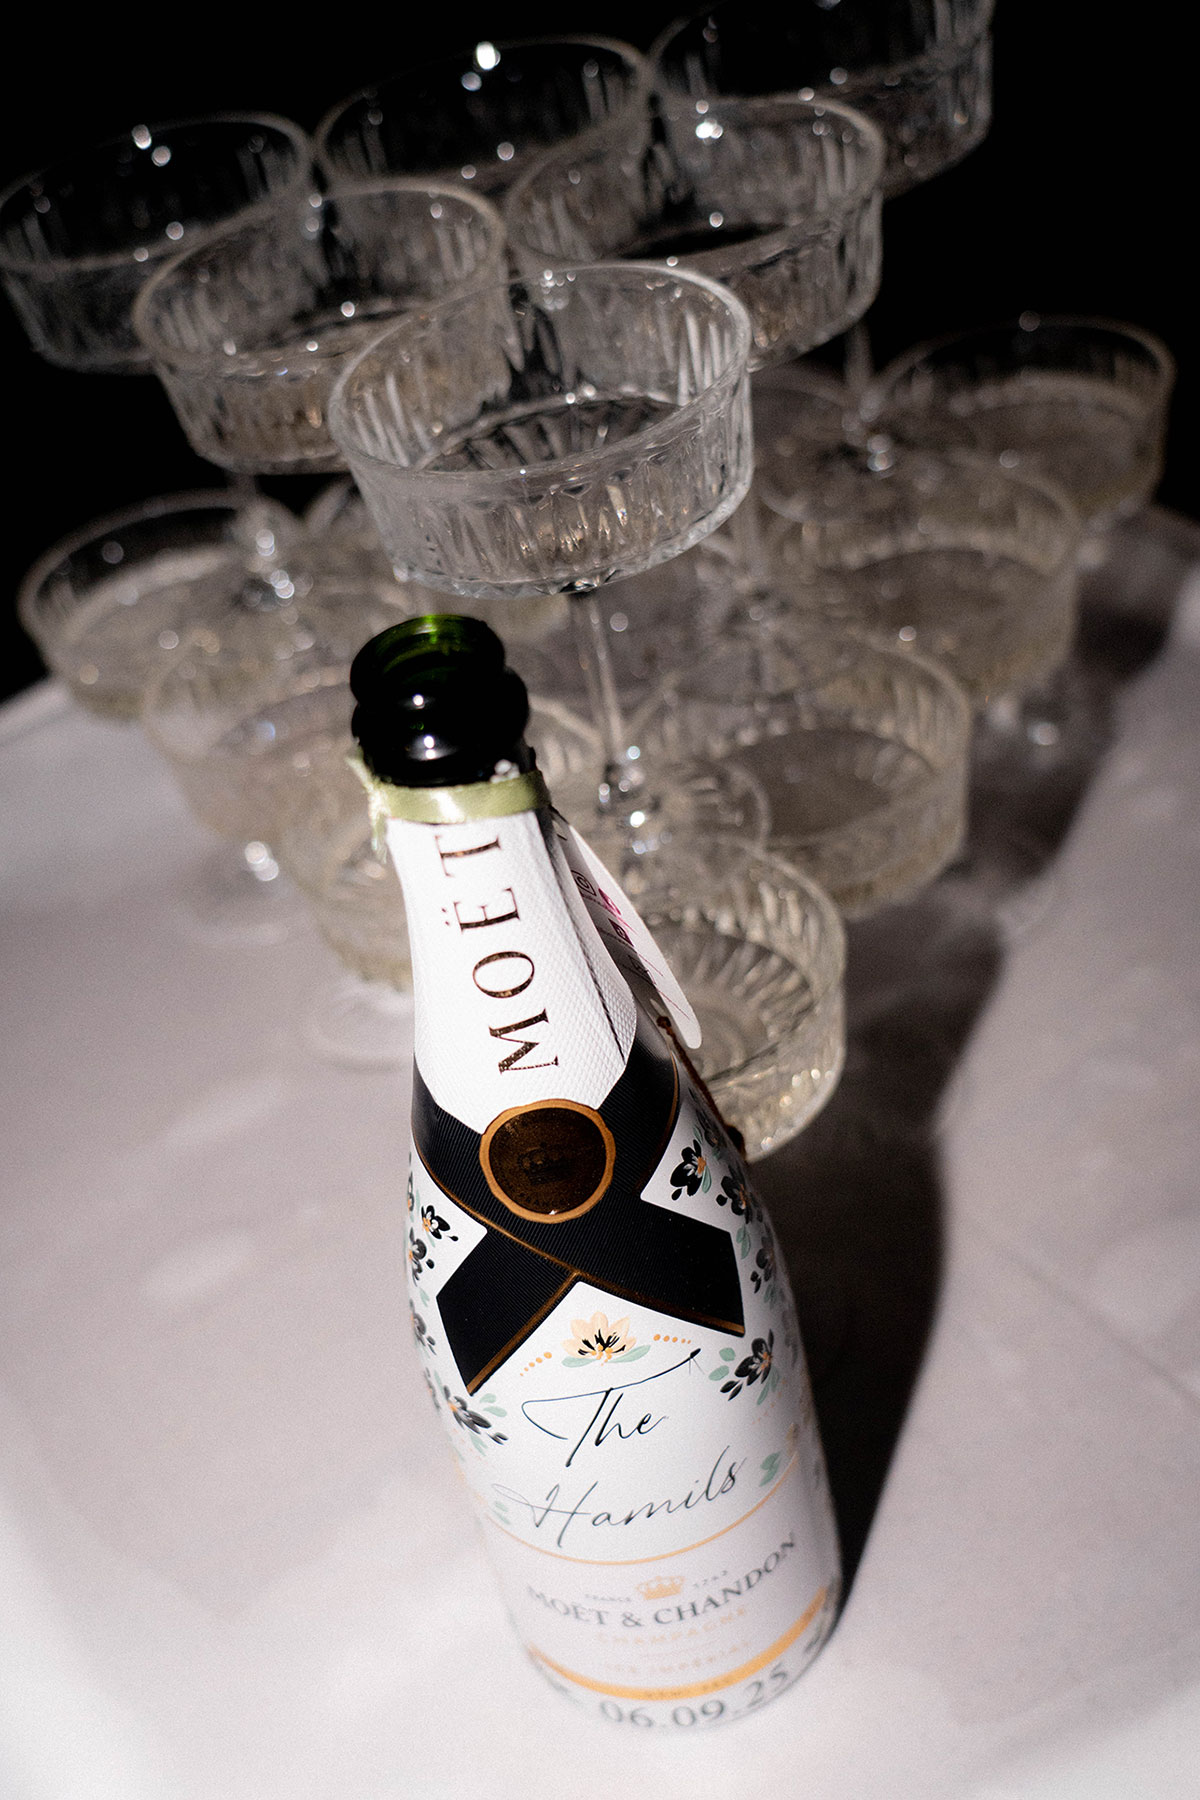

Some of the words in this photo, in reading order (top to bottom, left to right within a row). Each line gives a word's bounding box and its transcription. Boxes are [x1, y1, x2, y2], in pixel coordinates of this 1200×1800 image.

[434, 834, 559, 1075] MOËT
[521, 1348, 702, 1468] The
[491, 1445, 747, 1548] Hamils
[621, 1610, 646, 1628] &
[653, 1531, 796, 1626] CHANDON
[598, 1661, 791, 1730] 06.09.25
